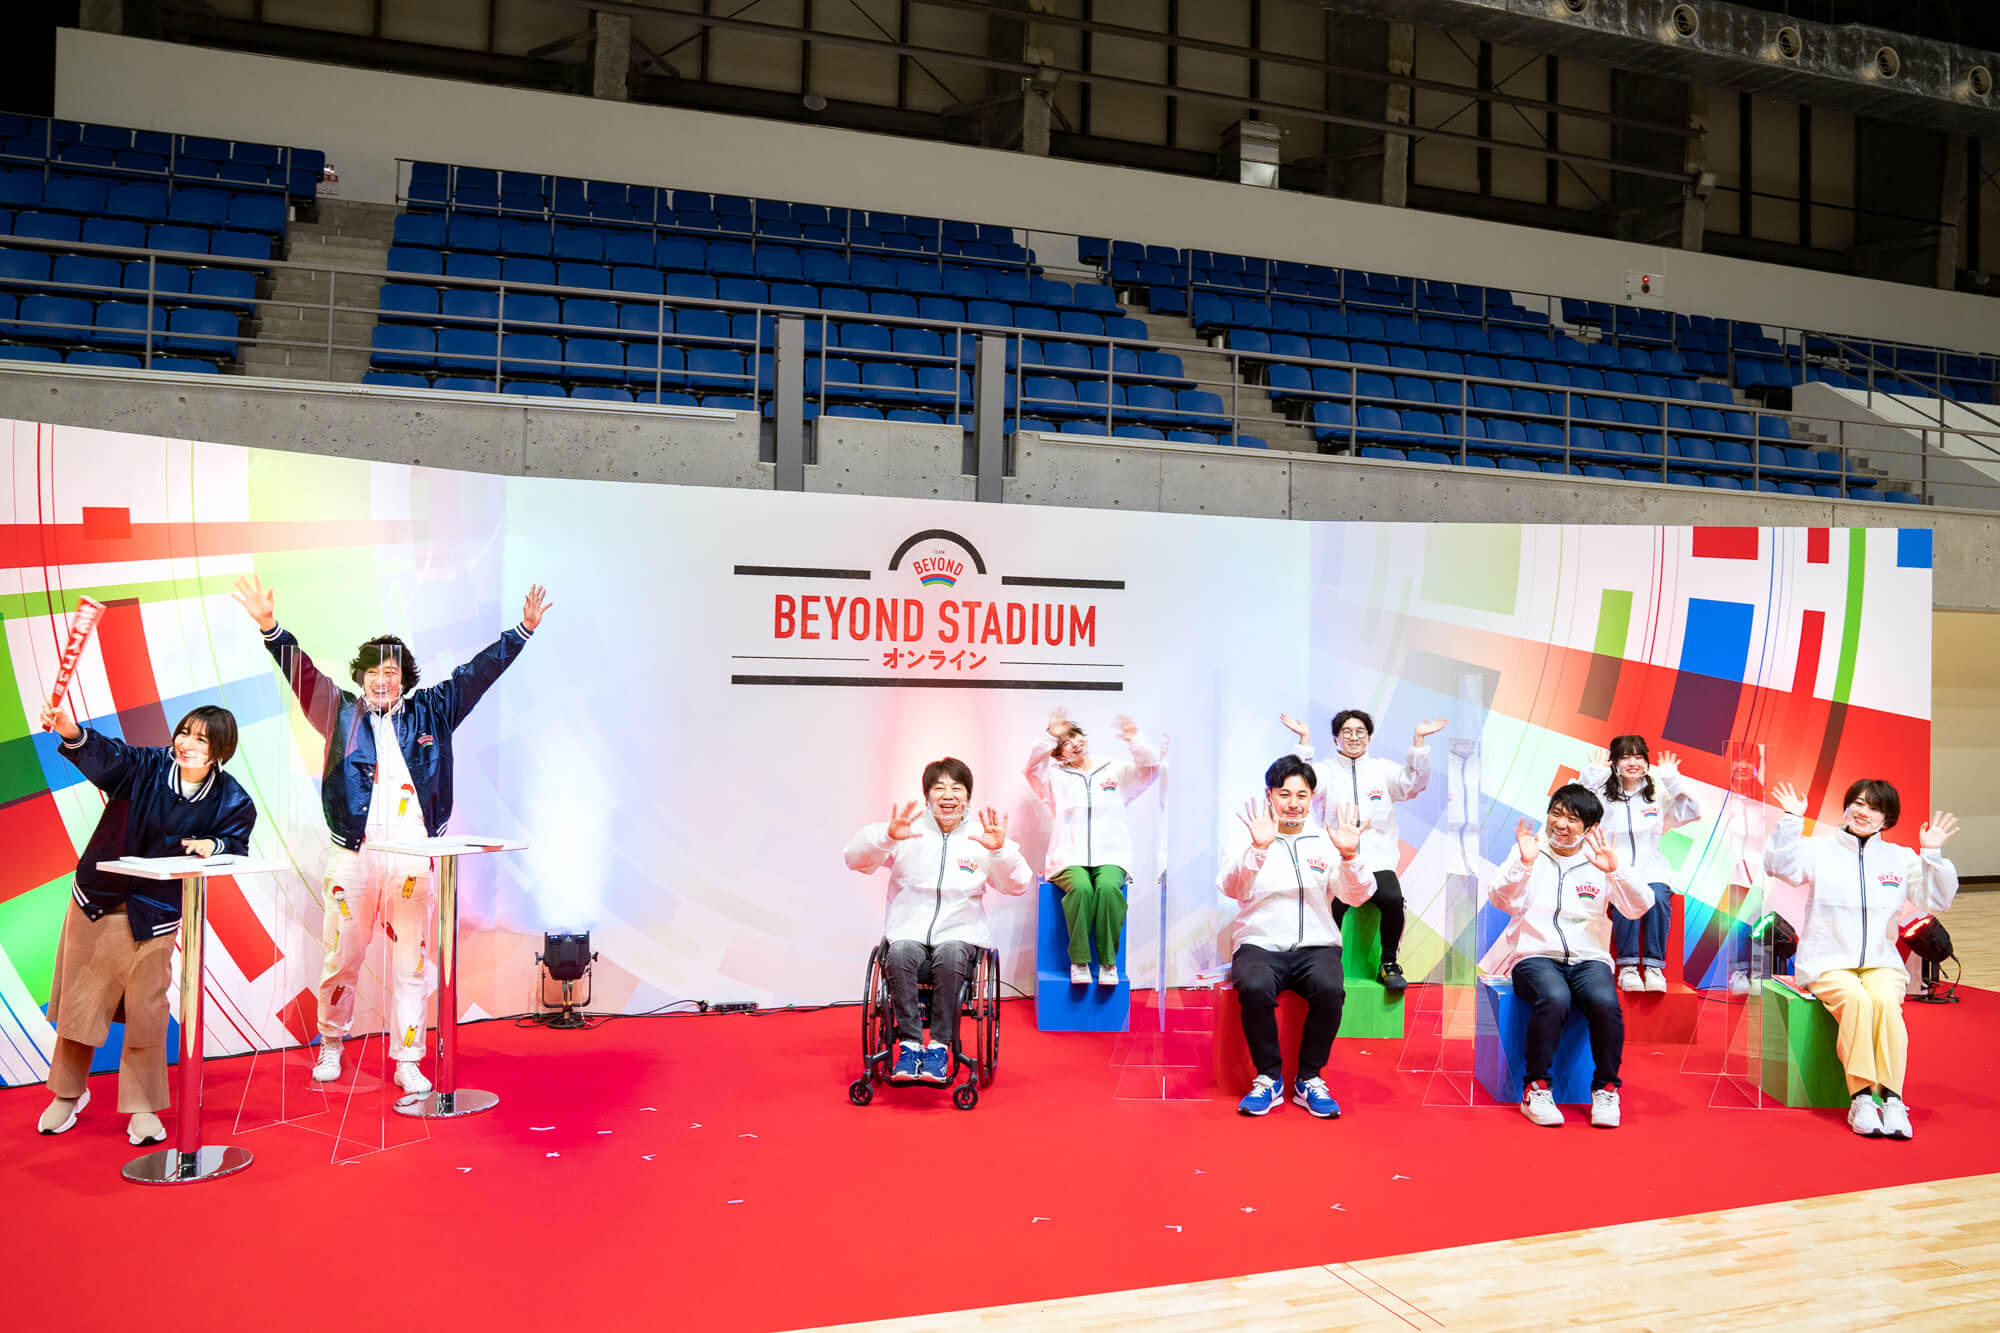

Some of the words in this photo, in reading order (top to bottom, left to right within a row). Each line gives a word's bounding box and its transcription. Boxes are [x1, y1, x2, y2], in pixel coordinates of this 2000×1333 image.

[913, 557, 964, 576] BEYOND
[774, 594, 924, 642] BEYOND
[938, 600, 1097, 647] STADIUM
[882, 647, 988, 672] オンライン
[1576, 885, 1600, 894] BEYOND
